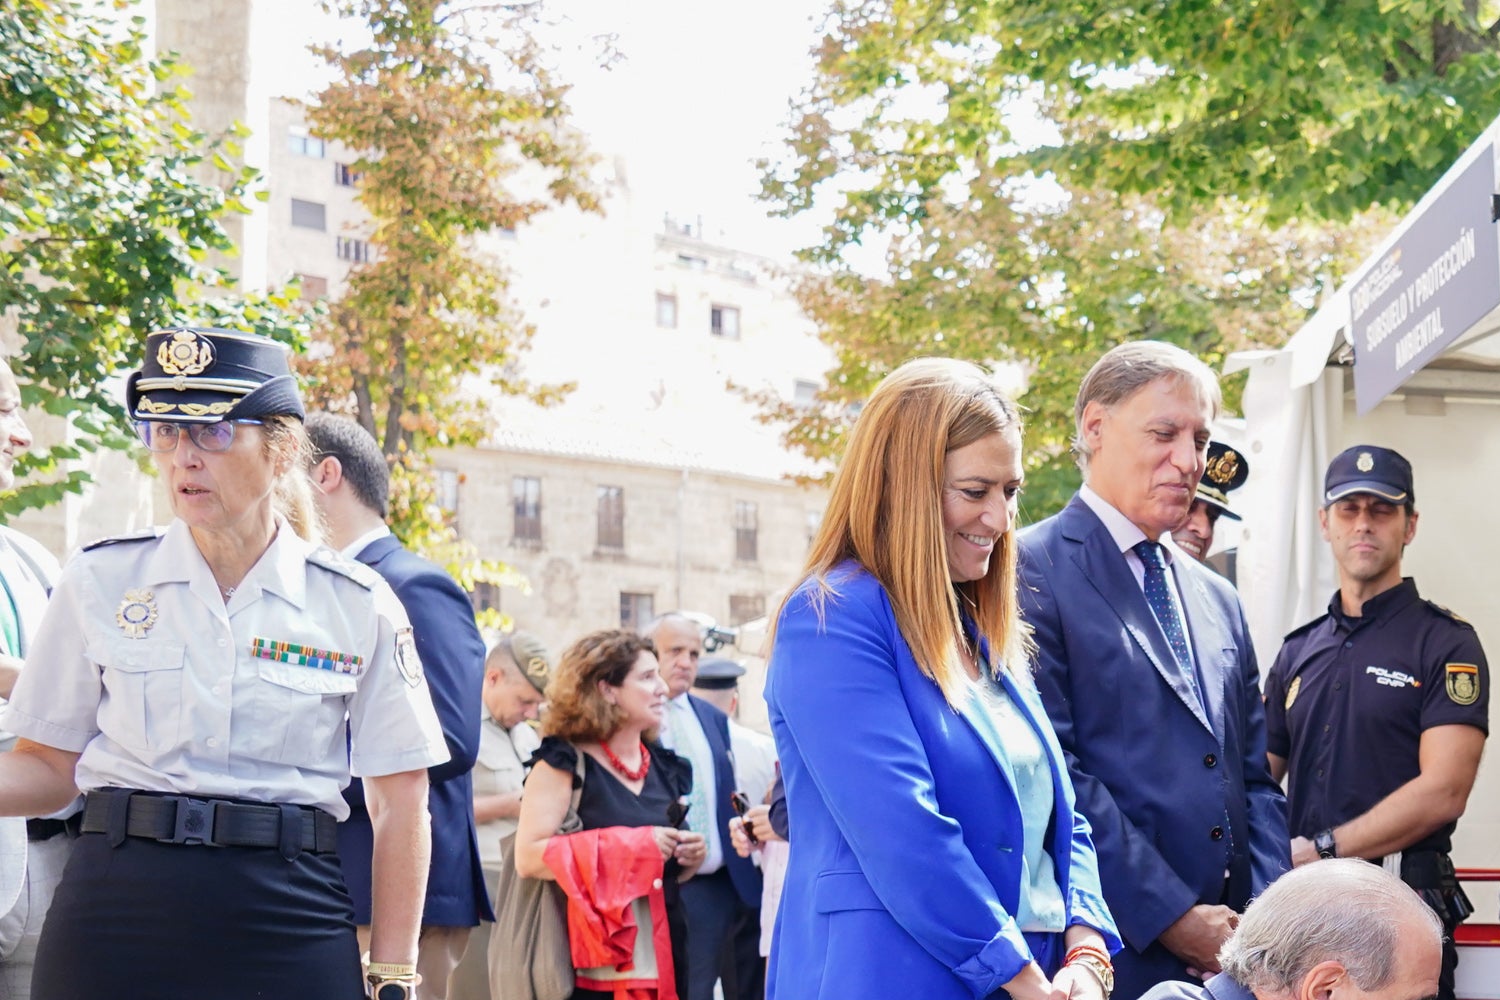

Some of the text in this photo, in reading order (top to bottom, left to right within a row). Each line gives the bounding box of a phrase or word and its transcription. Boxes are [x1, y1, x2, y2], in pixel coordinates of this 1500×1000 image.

[1366, 292, 1408, 352] SUBSUELO
[1407, 284, 1415, 313] Y
[1415, 227, 1475, 308] PROTECCIÓN
[1396, 307, 1444, 370] AMBIENTAL
[1366, 666, 1415, 684] POLICIA
[1376, 677, 1406, 688] CNP
